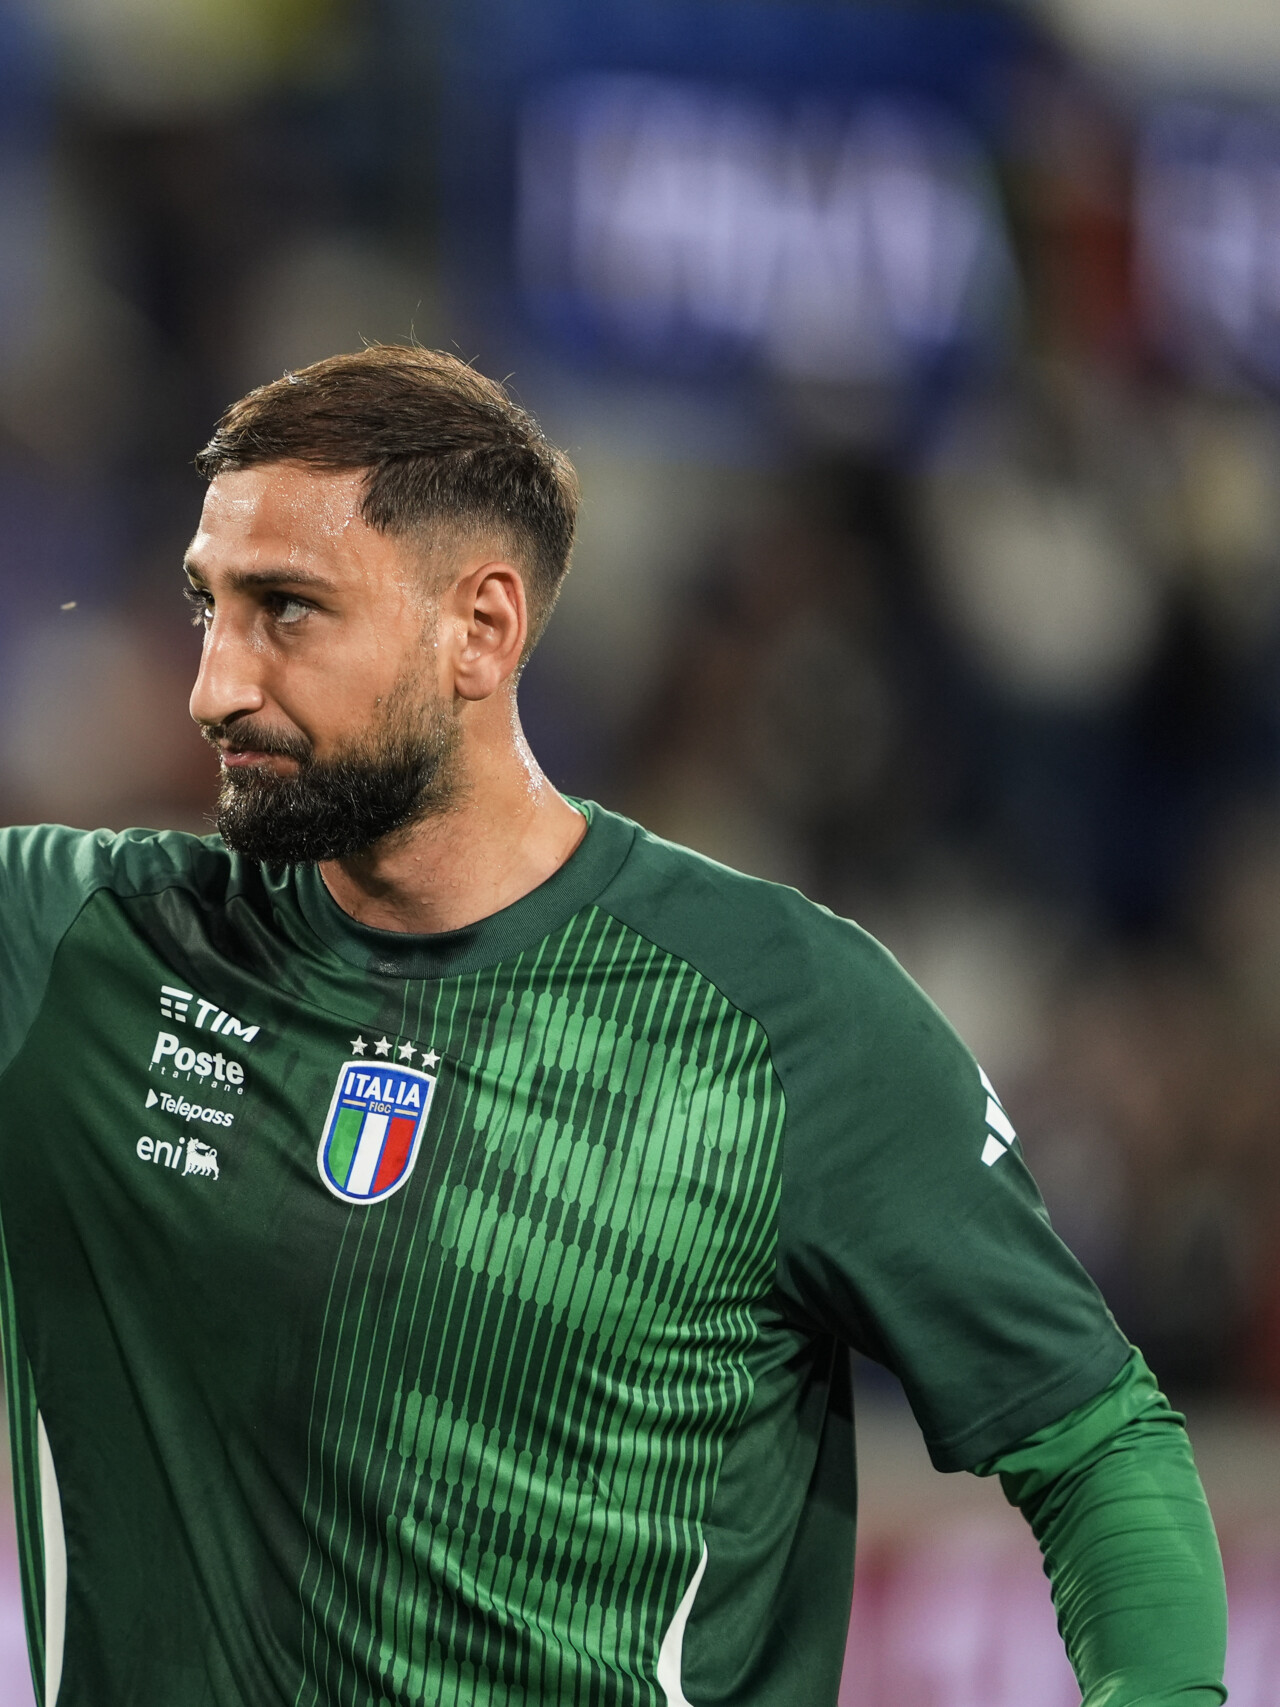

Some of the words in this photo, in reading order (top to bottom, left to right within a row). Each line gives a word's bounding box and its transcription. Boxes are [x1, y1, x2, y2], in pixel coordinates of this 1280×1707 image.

[194, 998, 260, 1043] TIM
[151, 1031, 245, 1085] Poste
[148, 1062, 244, 1095] italiane
[344, 1071, 421, 1108] ITALIA
[160, 1092, 235, 1127] Telepass
[368, 1101, 392, 1114] FIGC
[136, 1136, 185, 1169] eni
